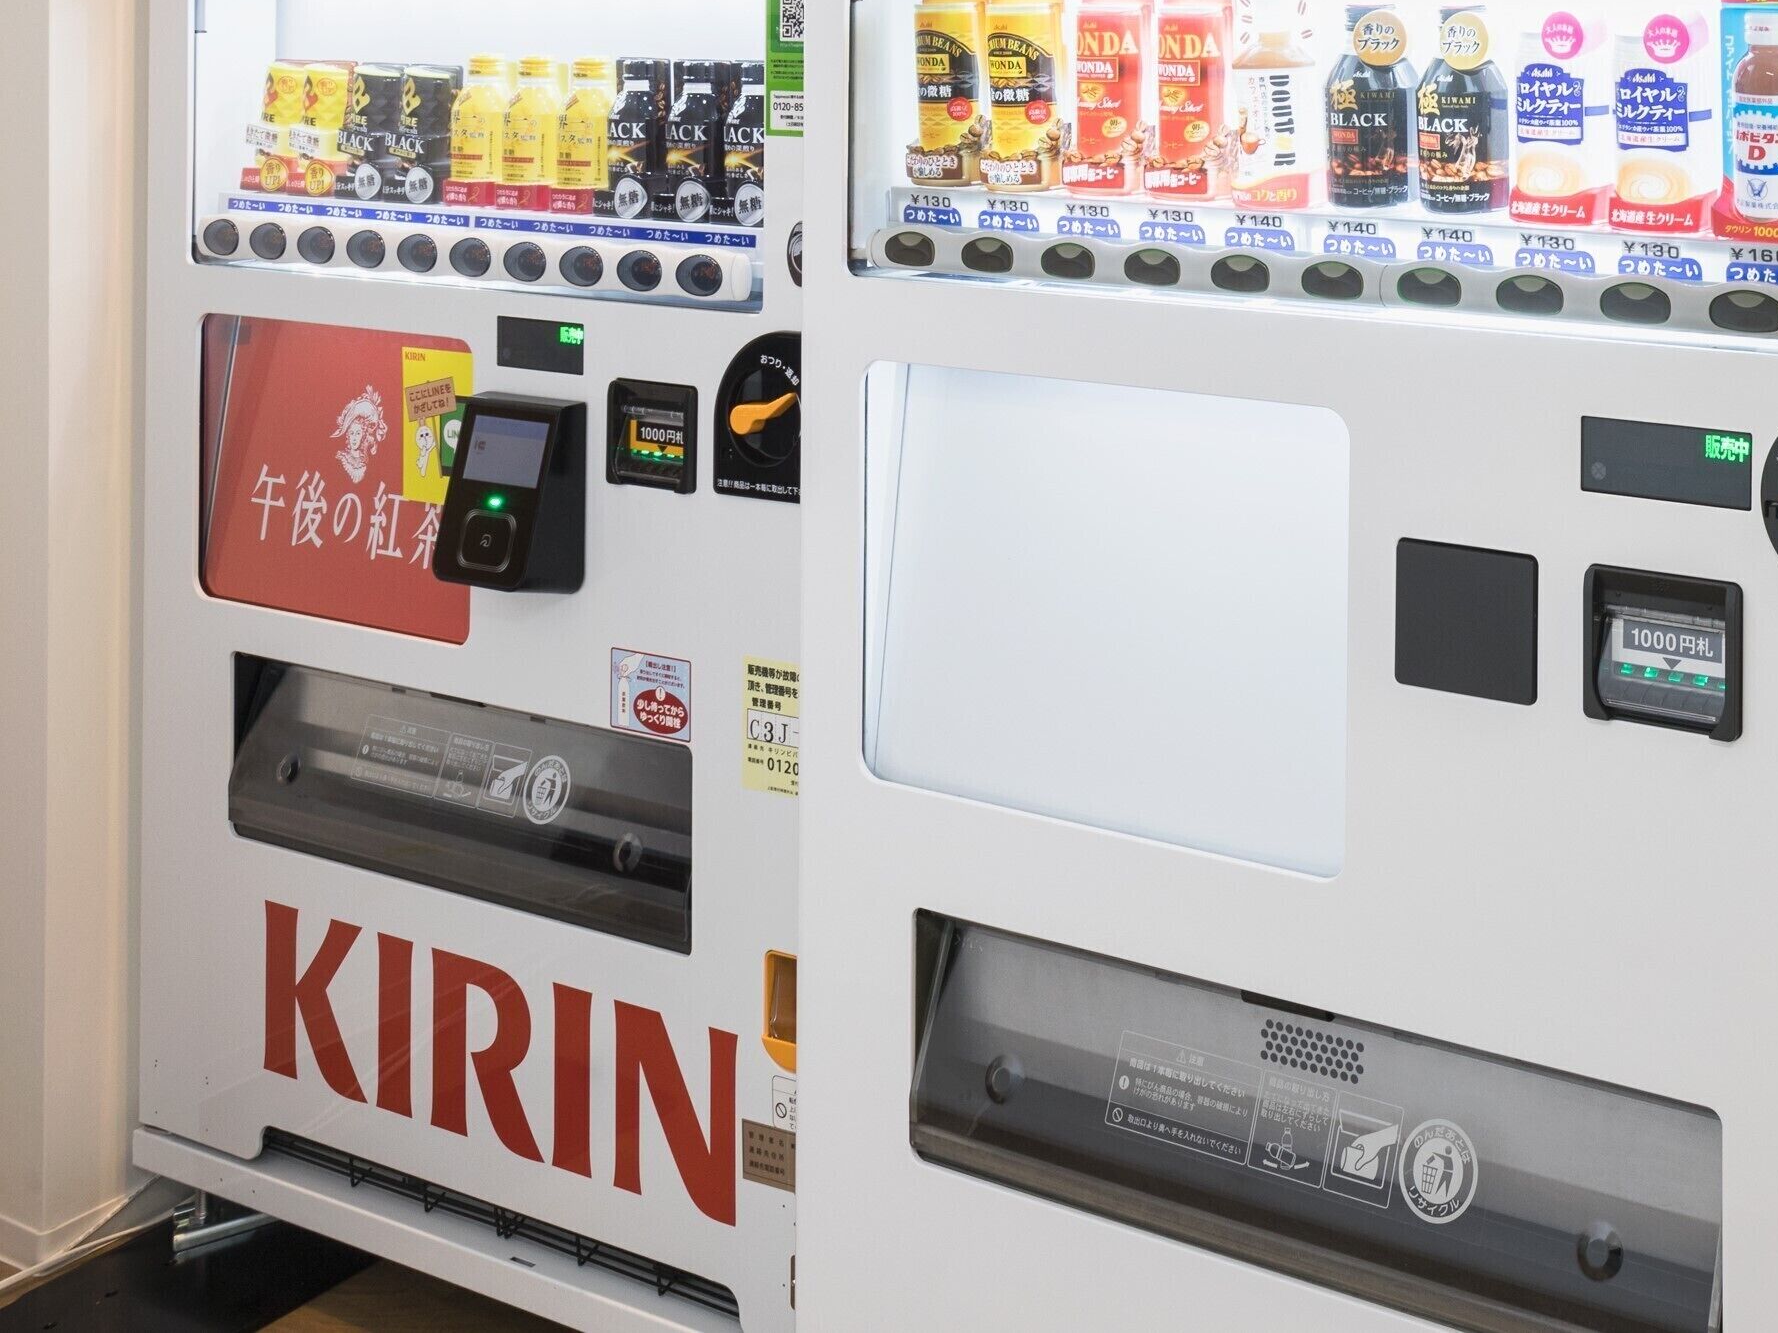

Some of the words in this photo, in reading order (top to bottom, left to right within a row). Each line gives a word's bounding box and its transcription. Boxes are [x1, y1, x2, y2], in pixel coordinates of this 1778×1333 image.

[1363, 23, 1394, 35] 香りの
[1447, 25, 1476, 37] 香りの
[932, 36, 962, 58] BEANS
[1358, 37, 1400, 51] ブラック
[1442, 41, 1480, 54] ブラック
[1531, 68, 1553, 77] Asahi
[1330, 79, 1358, 111] 極
[1519, 82, 1573, 97] ロイヤル
[1619, 86, 1676, 103] ロイヤル
[1418, 82, 1440, 116] 極
[1441, 96, 1476, 105] KIWAMI
[1516, 98, 1581, 115] ミルクティー
[1331, 112, 1388, 127] BLACK
[1616, 103, 1686, 121] ミルクティー
[1418, 116, 1468, 133] BLACK
[384, 132, 425, 154] BLACK
[1748, 145, 1766, 161] D
[264, 174, 282, 186] UP!
[618, 189, 639, 207] 無糖
[680, 193, 704, 211] 無糖
[738, 195, 762, 214] 無糖
[1511, 200, 1586, 218] 北海道産生クリーム
[1612, 208, 1693, 227] 北海道産生クリーム
[1725, 225, 1752, 234] タウリン
[405, 352, 426, 362] KIRIN
[760, 354, 800, 386] おつり・返却
[408, 384, 452, 402] ここにLINEを
[640, 427, 684, 444] 1000円札
[1704, 434, 1750, 464] 販売中
[1630, 627, 1715, 658] 1000円札
[636, 699, 685, 717] 少し待ってから
[752, 698, 782, 712] 管理番号
[640, 713, 681, 729] ゆっくり開栓
[264, 899, 738, 1227] KIRIN
[1409, 1185, 1462, 1219] リサイクル
